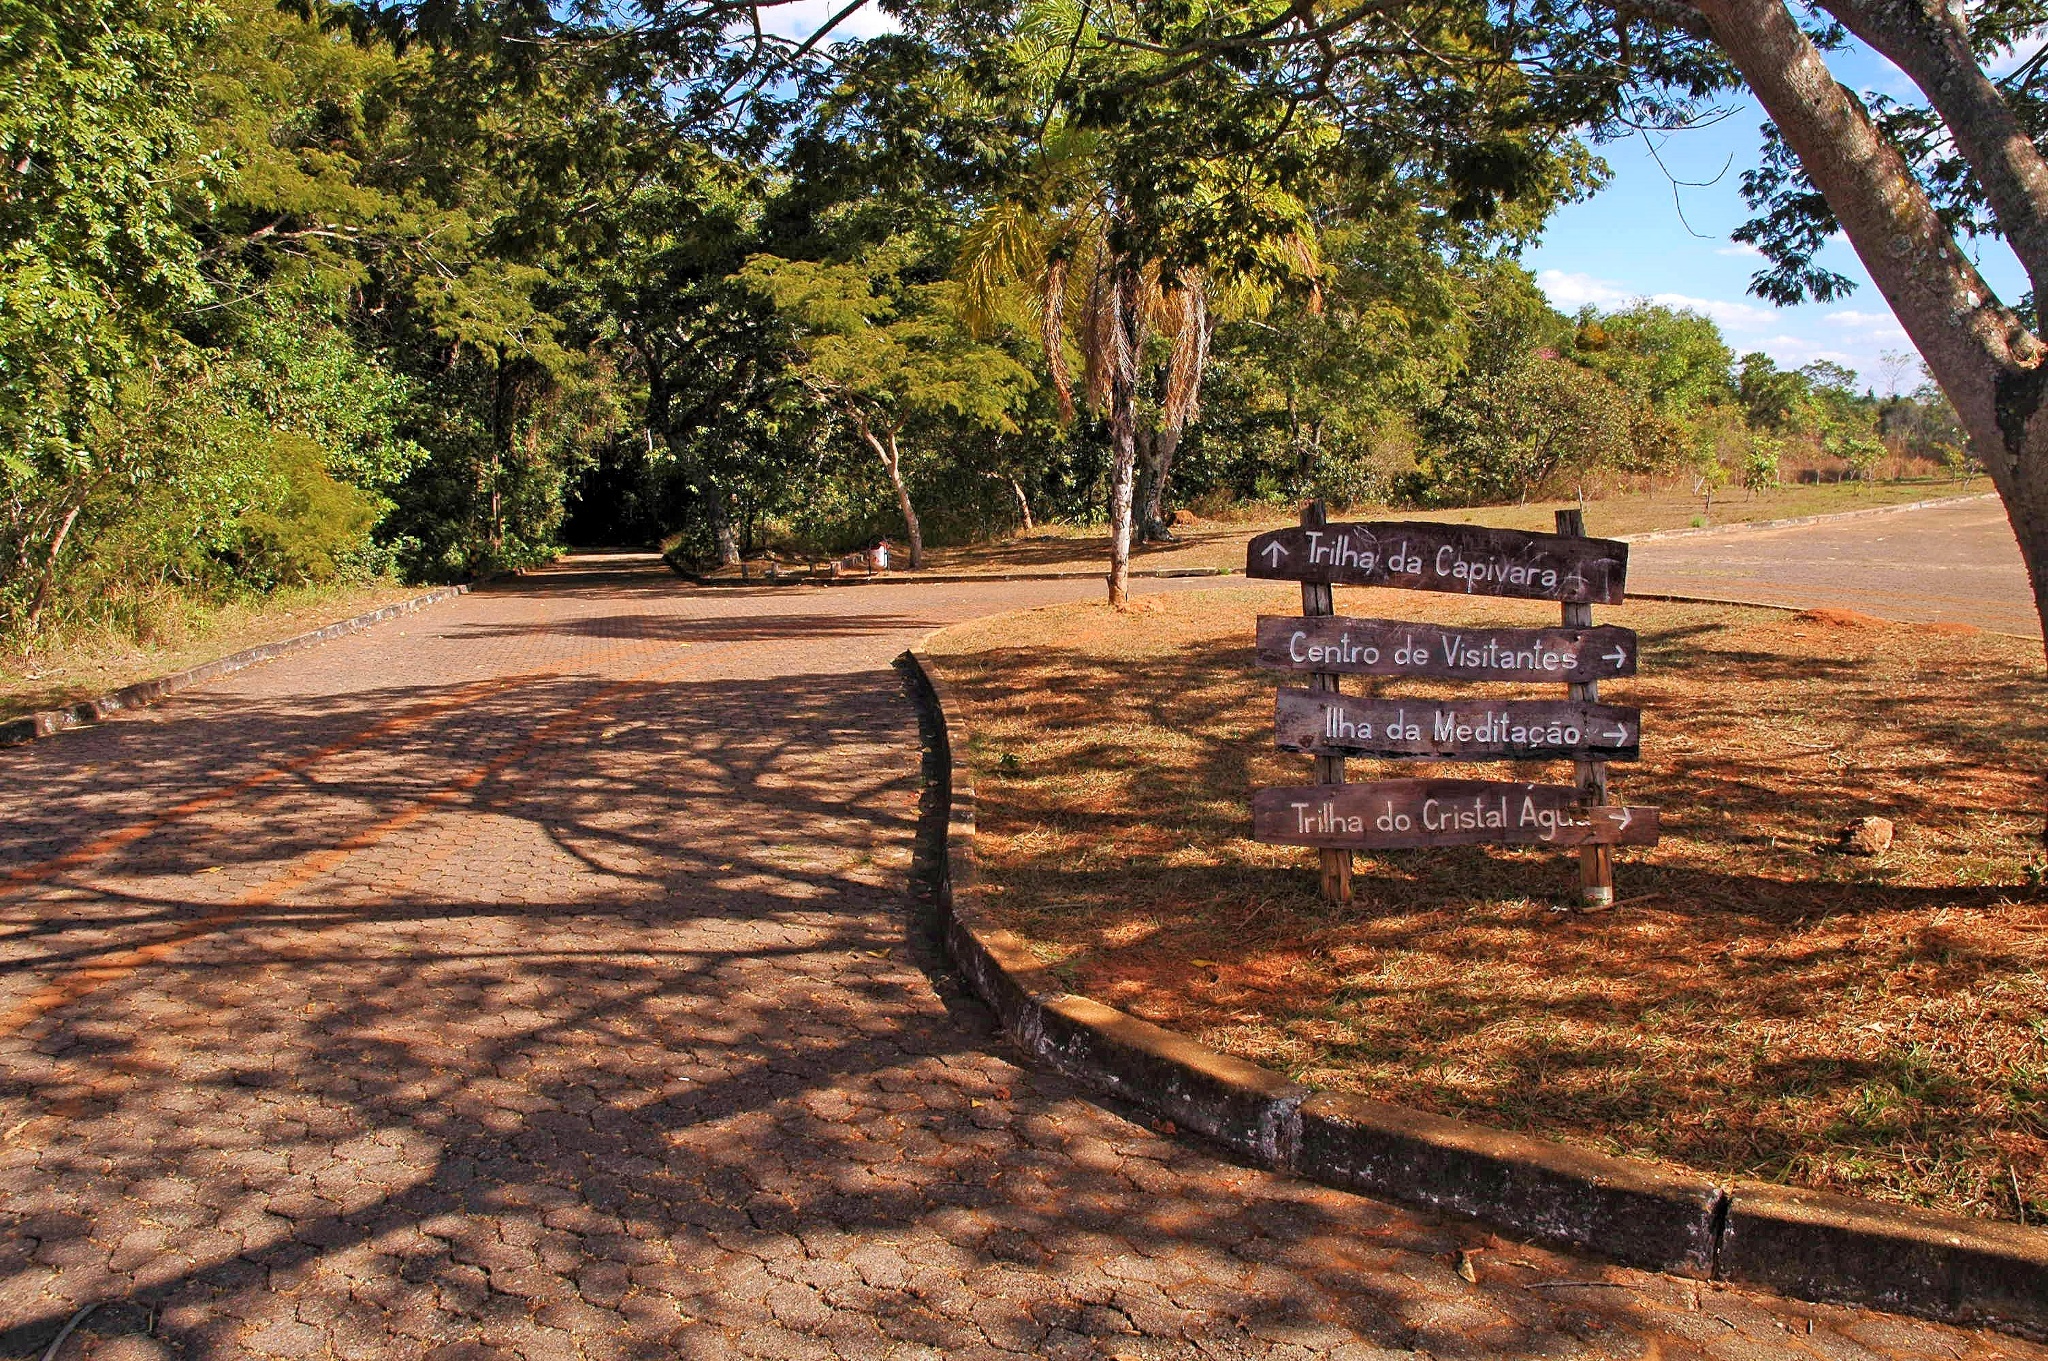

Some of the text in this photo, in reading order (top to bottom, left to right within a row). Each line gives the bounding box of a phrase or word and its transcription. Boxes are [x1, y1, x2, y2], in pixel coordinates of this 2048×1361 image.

[1305, 530, 1557, 593] Trilha da Capivara
[1289, 631, 1579, 670] Centro de Visitantes
[1325, 707, 1580, 748] Ilha da Meditação
[1290, 802, 1364, 834] Trilha
[1376, 801, 1411, 832] do
[1422, 799, 1508, 832] Cristal
